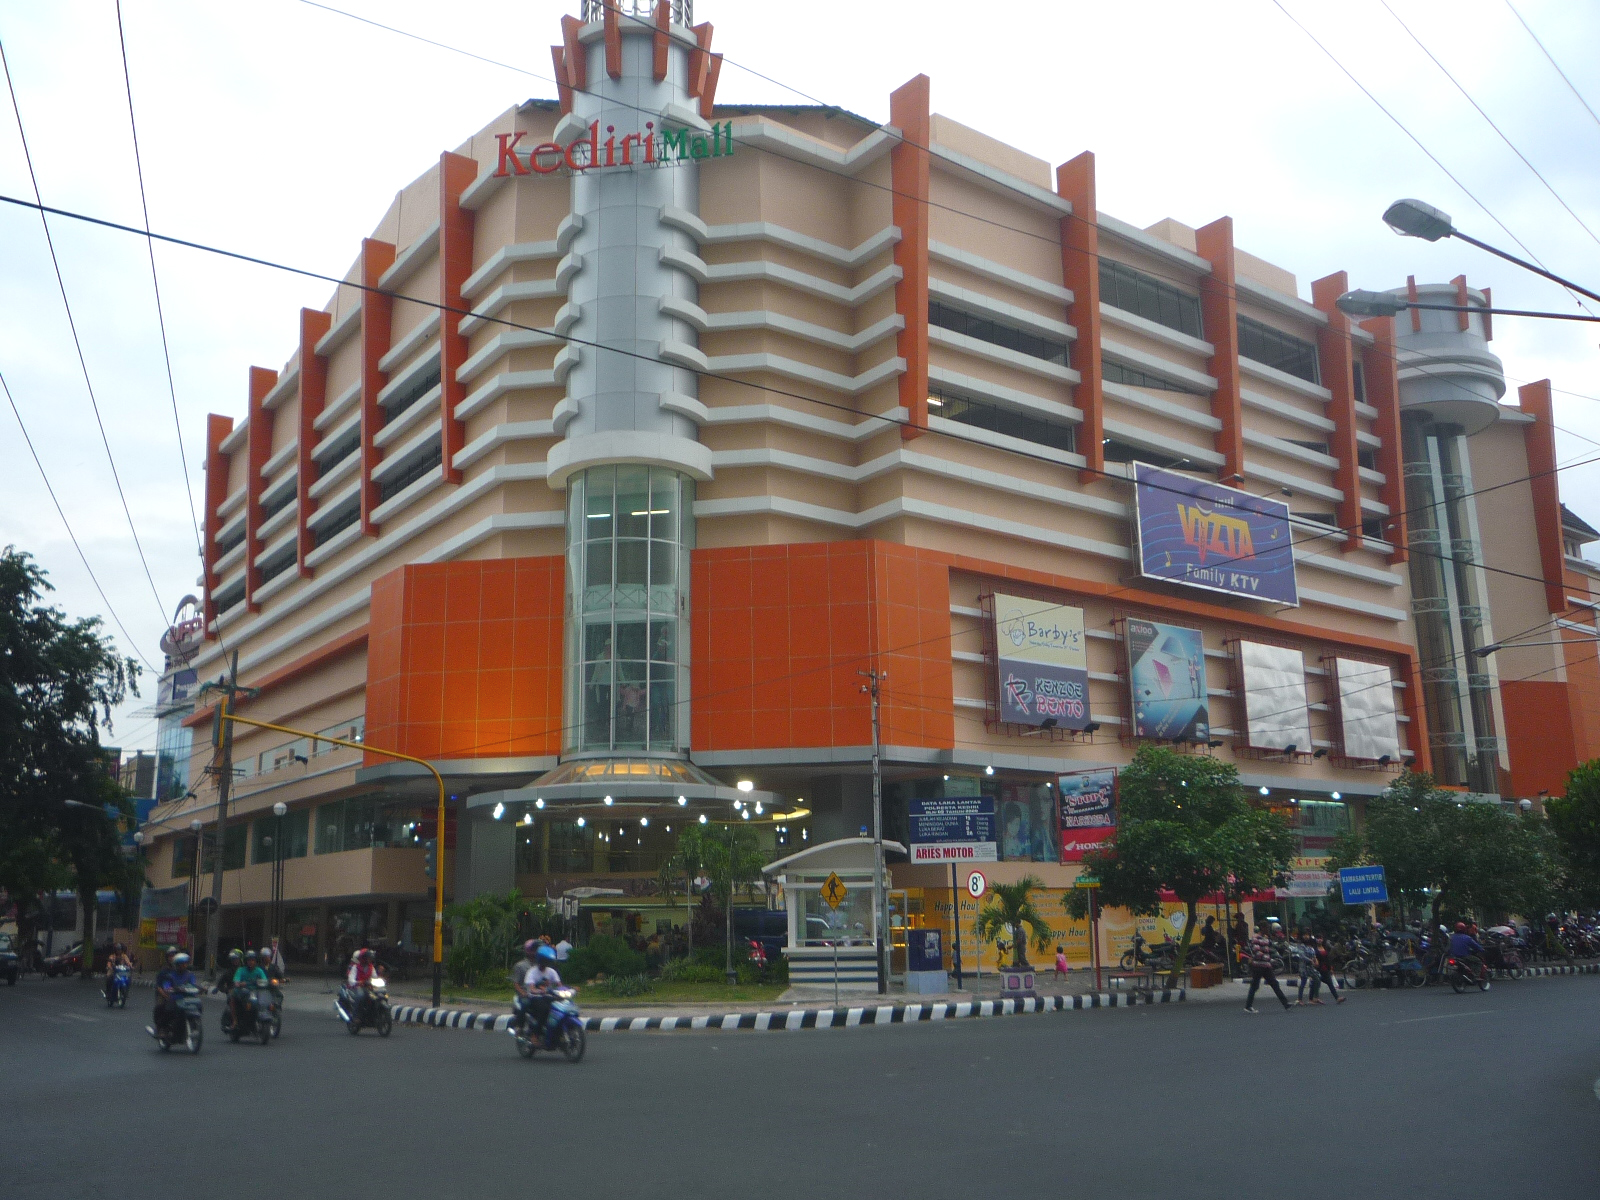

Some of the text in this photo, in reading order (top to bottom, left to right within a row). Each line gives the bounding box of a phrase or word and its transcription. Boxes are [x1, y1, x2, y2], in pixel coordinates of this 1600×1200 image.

[493, 119, 734, 178] Kediri Mall
[1186, 563, 1259, 591] Family KTV
[1027, 621, 1079, 645] Barby's
[1130, 623, 1153, 635] axioo
[1035, 677, 1083, 698] KENZOE
[1035, 695, 1084, 718] BENTO
[916, 847, 941, 860] ARIES
[943, 847, 974, 859] MOTOR
[1348, 886, 1380, 895] LALU LINTAS
[1068, 926, 1087, 937] Hour
